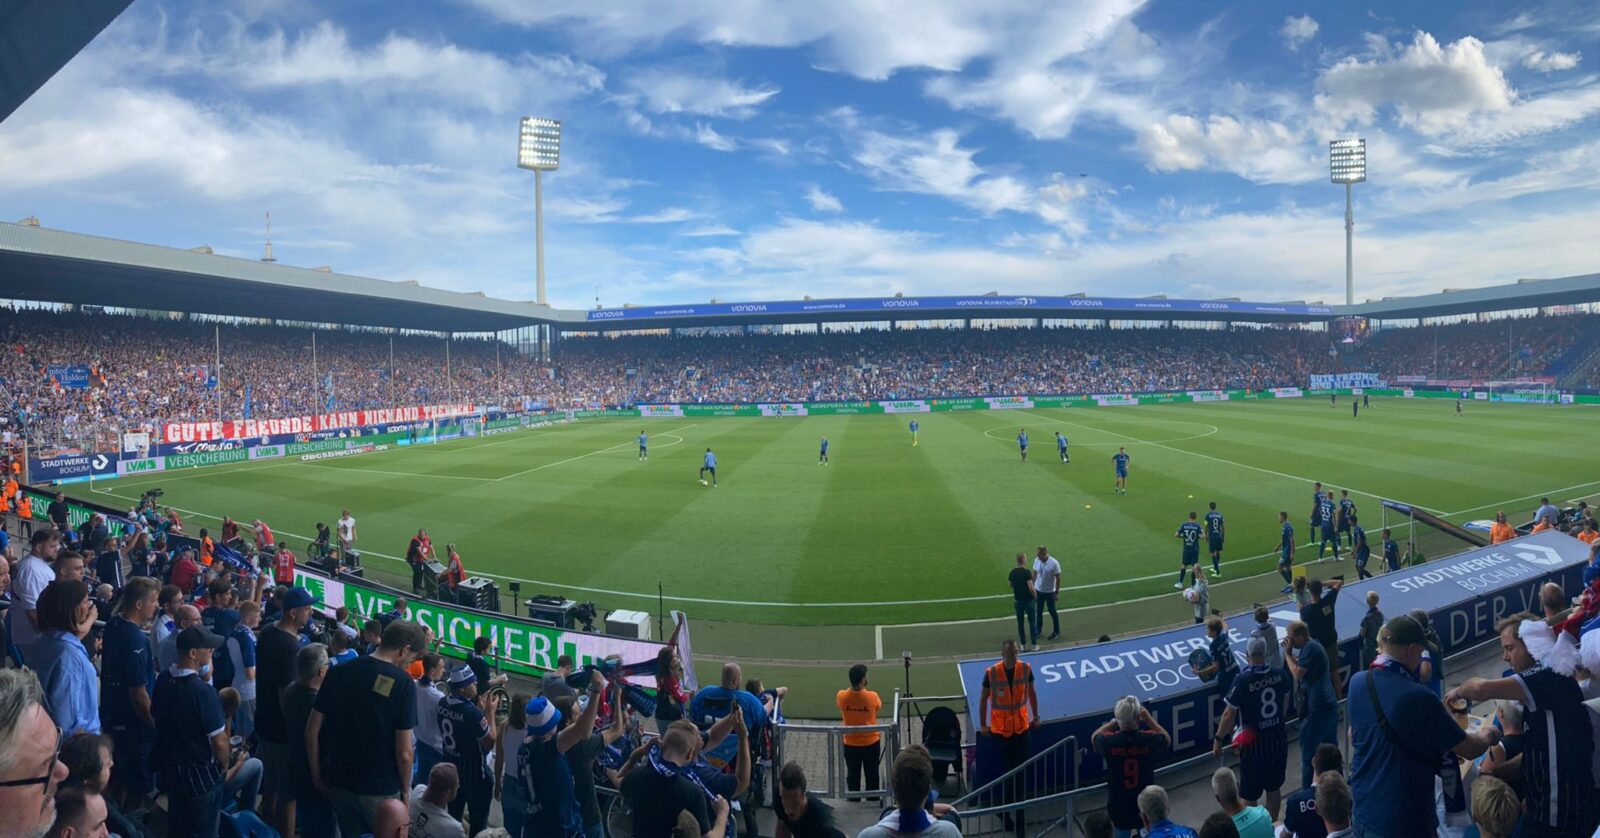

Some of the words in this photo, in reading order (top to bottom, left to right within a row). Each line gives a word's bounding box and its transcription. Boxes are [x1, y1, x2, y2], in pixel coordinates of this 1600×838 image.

[167, 421, 224, 442] GUTE
[233, 416, 312, 438] FREUNDE
[320, 411, 358, 431] KANN
[41, 456, 89, 468] STADTWERKE
[59, 465, 90, 475] BOCHUM
[169, 449, 246, 468] VERSICHERUNG
[1184, 529, 1197, 542] 30
[1391, 552, 1511, 593] STADTWERKE
[1456, 562, 1534, 592] BOCHUM
[1041, 625, 1249, 685] STADTWERE
[1249, 674, 1282, 692] BOCHUM
[1260, 687, 1278, 719] 8
[442, 718, 456, 750] 8
[1123, 758, 1139, 790] 9
